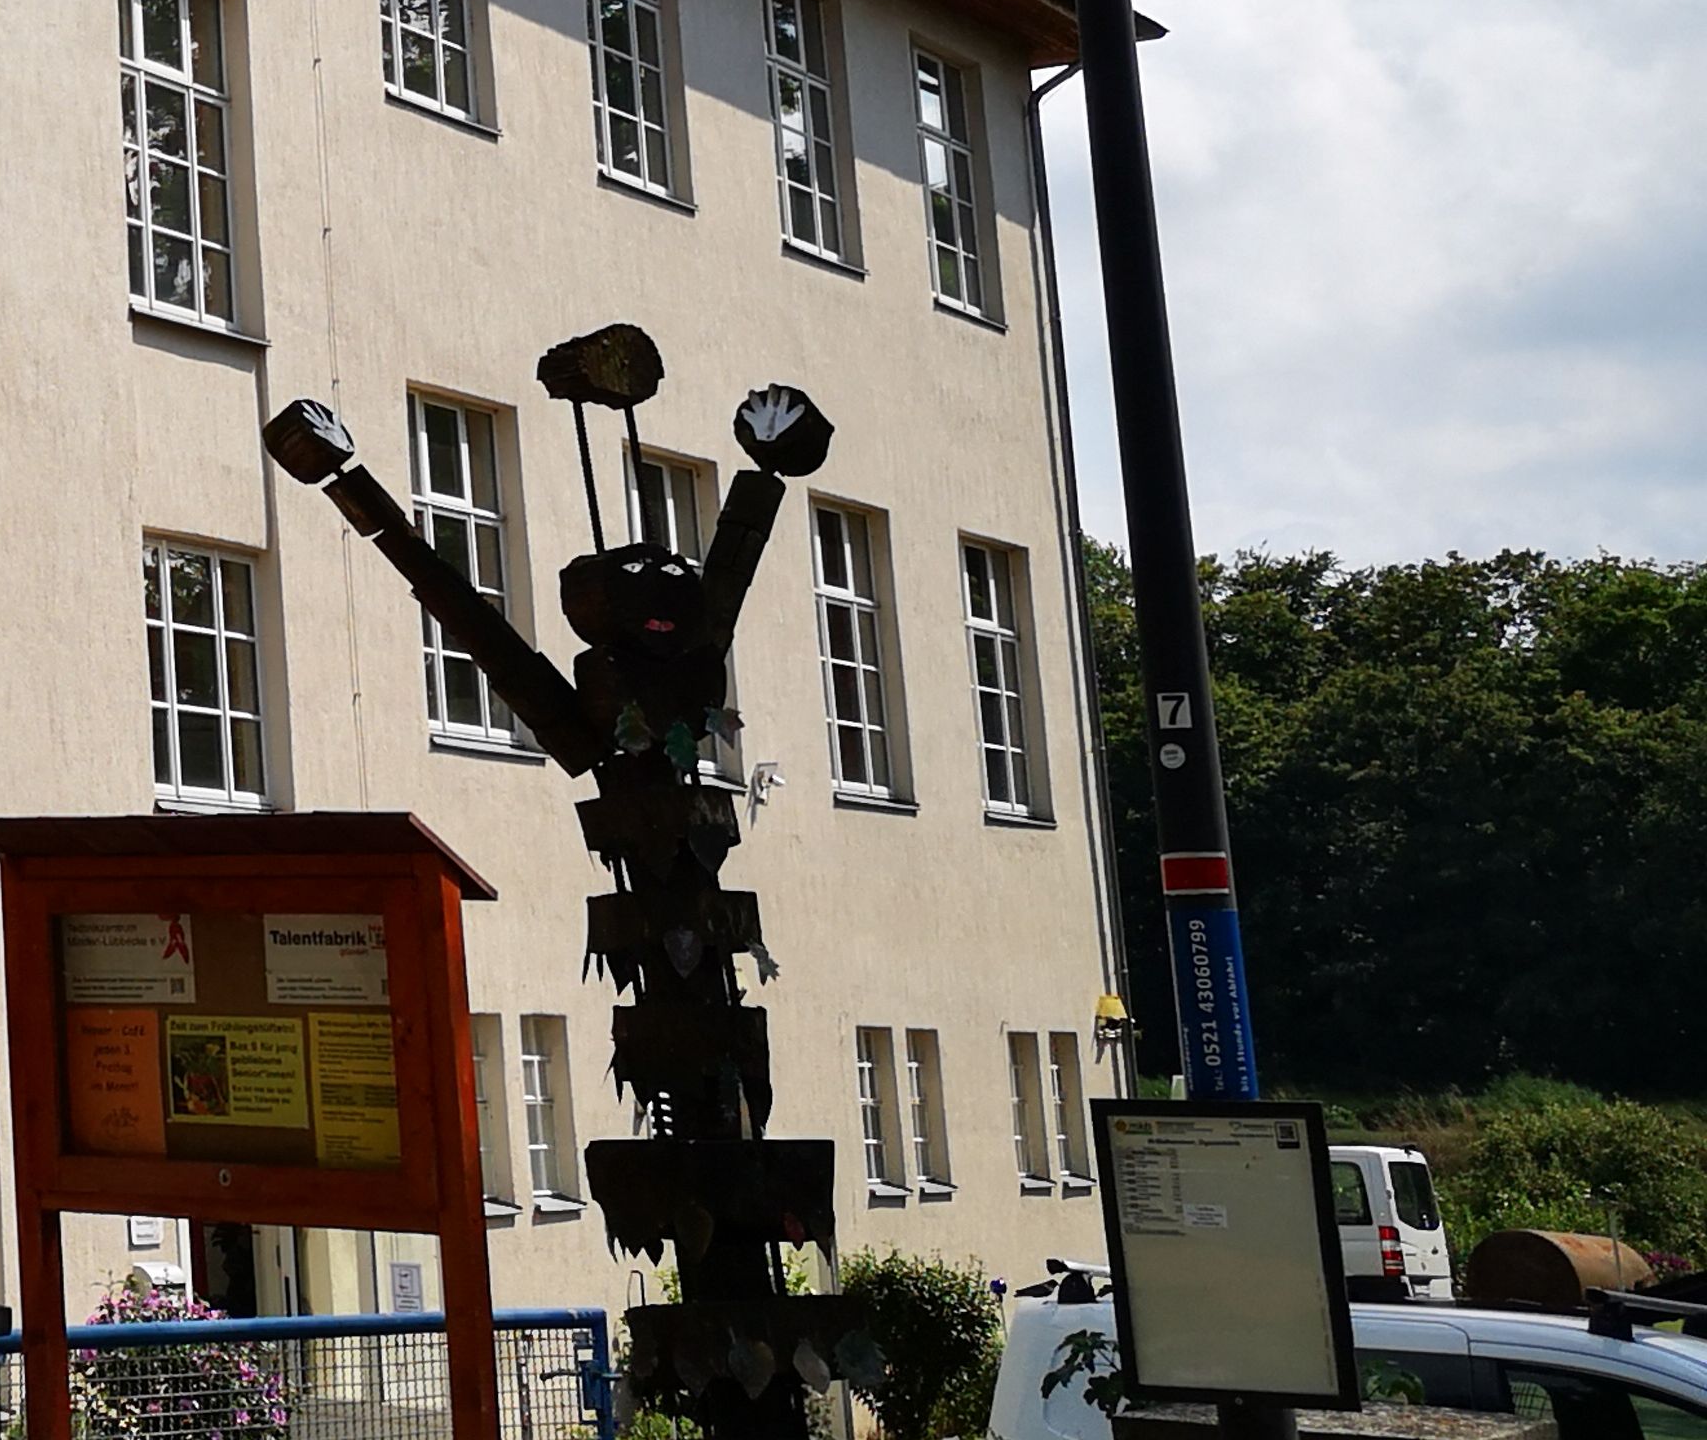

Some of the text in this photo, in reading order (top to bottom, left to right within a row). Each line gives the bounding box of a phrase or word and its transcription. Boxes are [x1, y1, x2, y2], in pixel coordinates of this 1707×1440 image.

[1161, 695, 1185, 725] 7
[269, 929, 367, 946] Talentfabrik
[1188, 919, 1216, 1013] 43060799
[1224, 956, 1239, 999] Abfahrt
[1231, 1001, 1241, 1020] vor
[1201, 1020, 1222, 1067] 0521
[1233, 1023, 1247, 1062] Stunde
